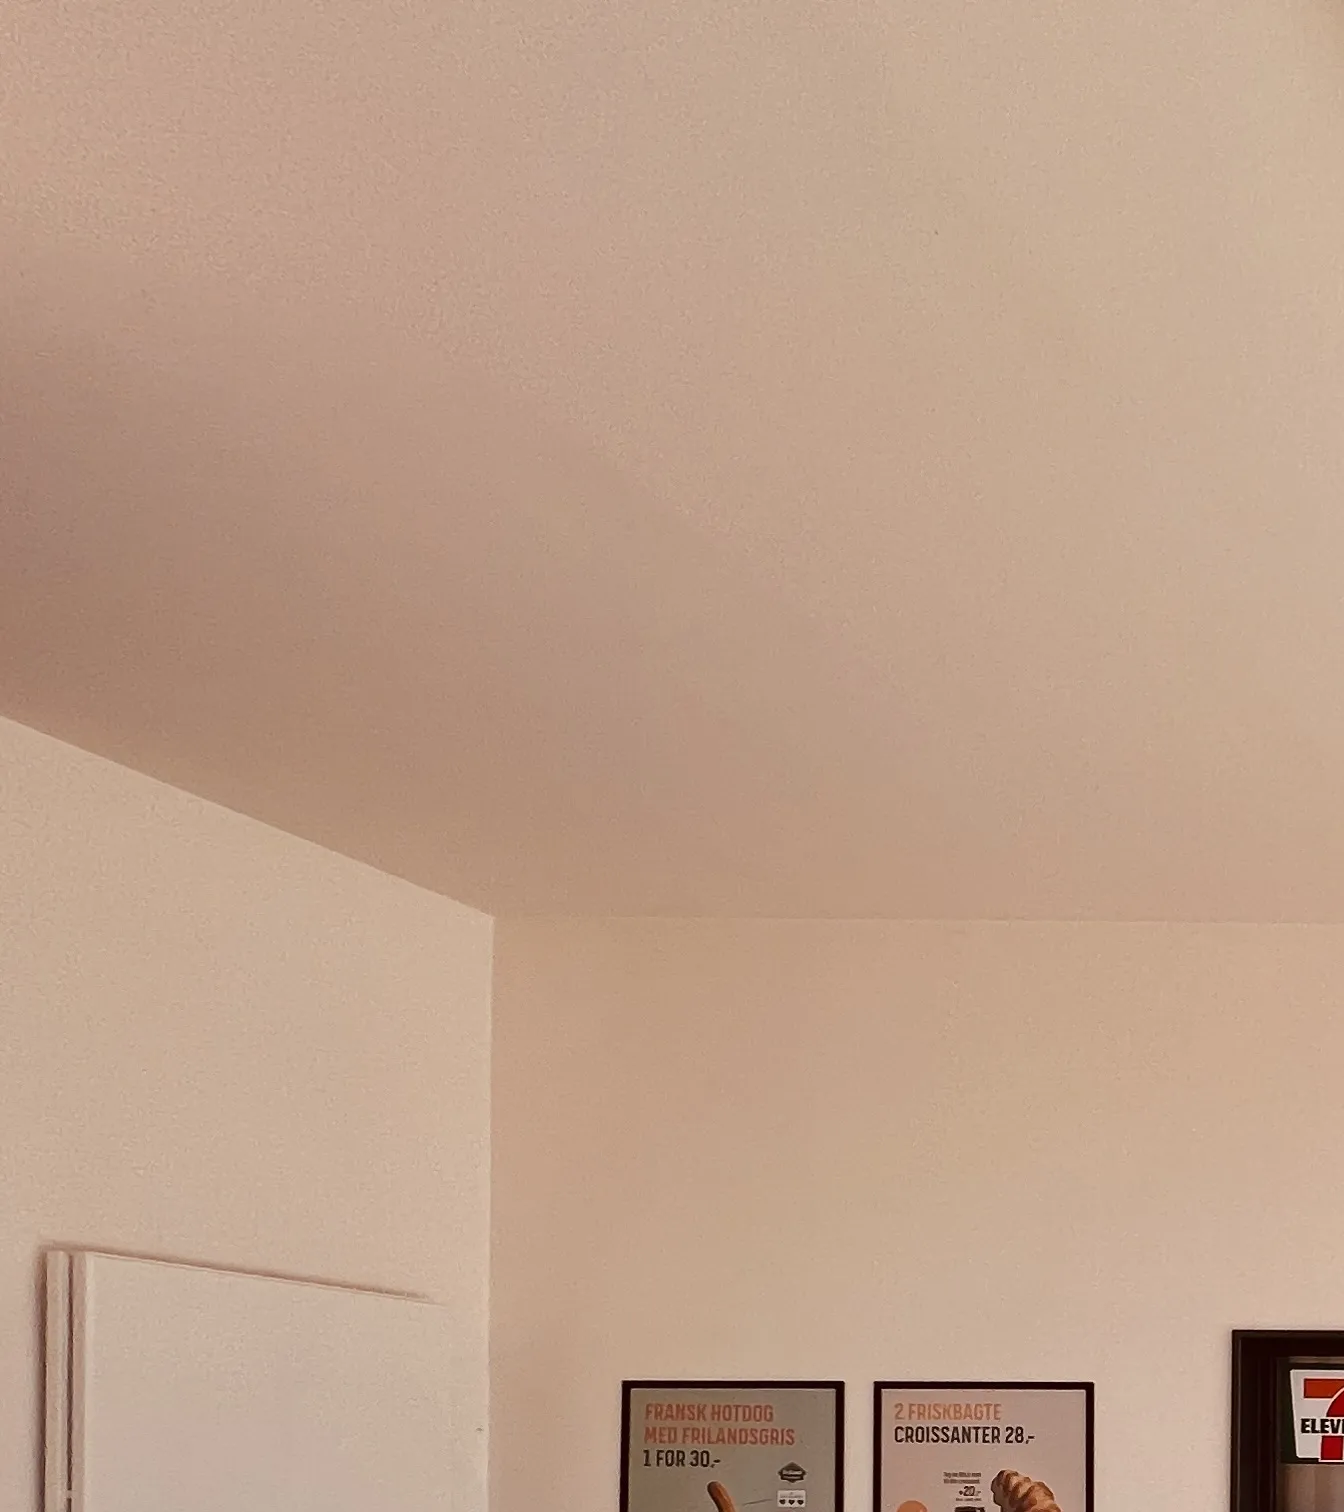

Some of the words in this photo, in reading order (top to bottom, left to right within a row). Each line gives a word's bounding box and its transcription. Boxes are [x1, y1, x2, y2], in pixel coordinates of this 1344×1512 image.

[644, 1403, 707, 1421] FRANSK
[711, 1404, 774, 1422] HOTDOG
[894, 1402, 904, 1420] 2
[908, 1403, 1002, 1421] FRISKBAGTE
[643, 1426, 677, 1444] MED
[682, 1427, 796, 1446] FRILANDSGRIS
[894, 1425, 1001, 1444] CROISSANTER
[1005, 1426, 1035, 1444] 28,-
[643, 1449, 651, 1467] 1
[656, 1449, 686, 1468] FOR
[689, 1450, 721, 1469] 30,-
